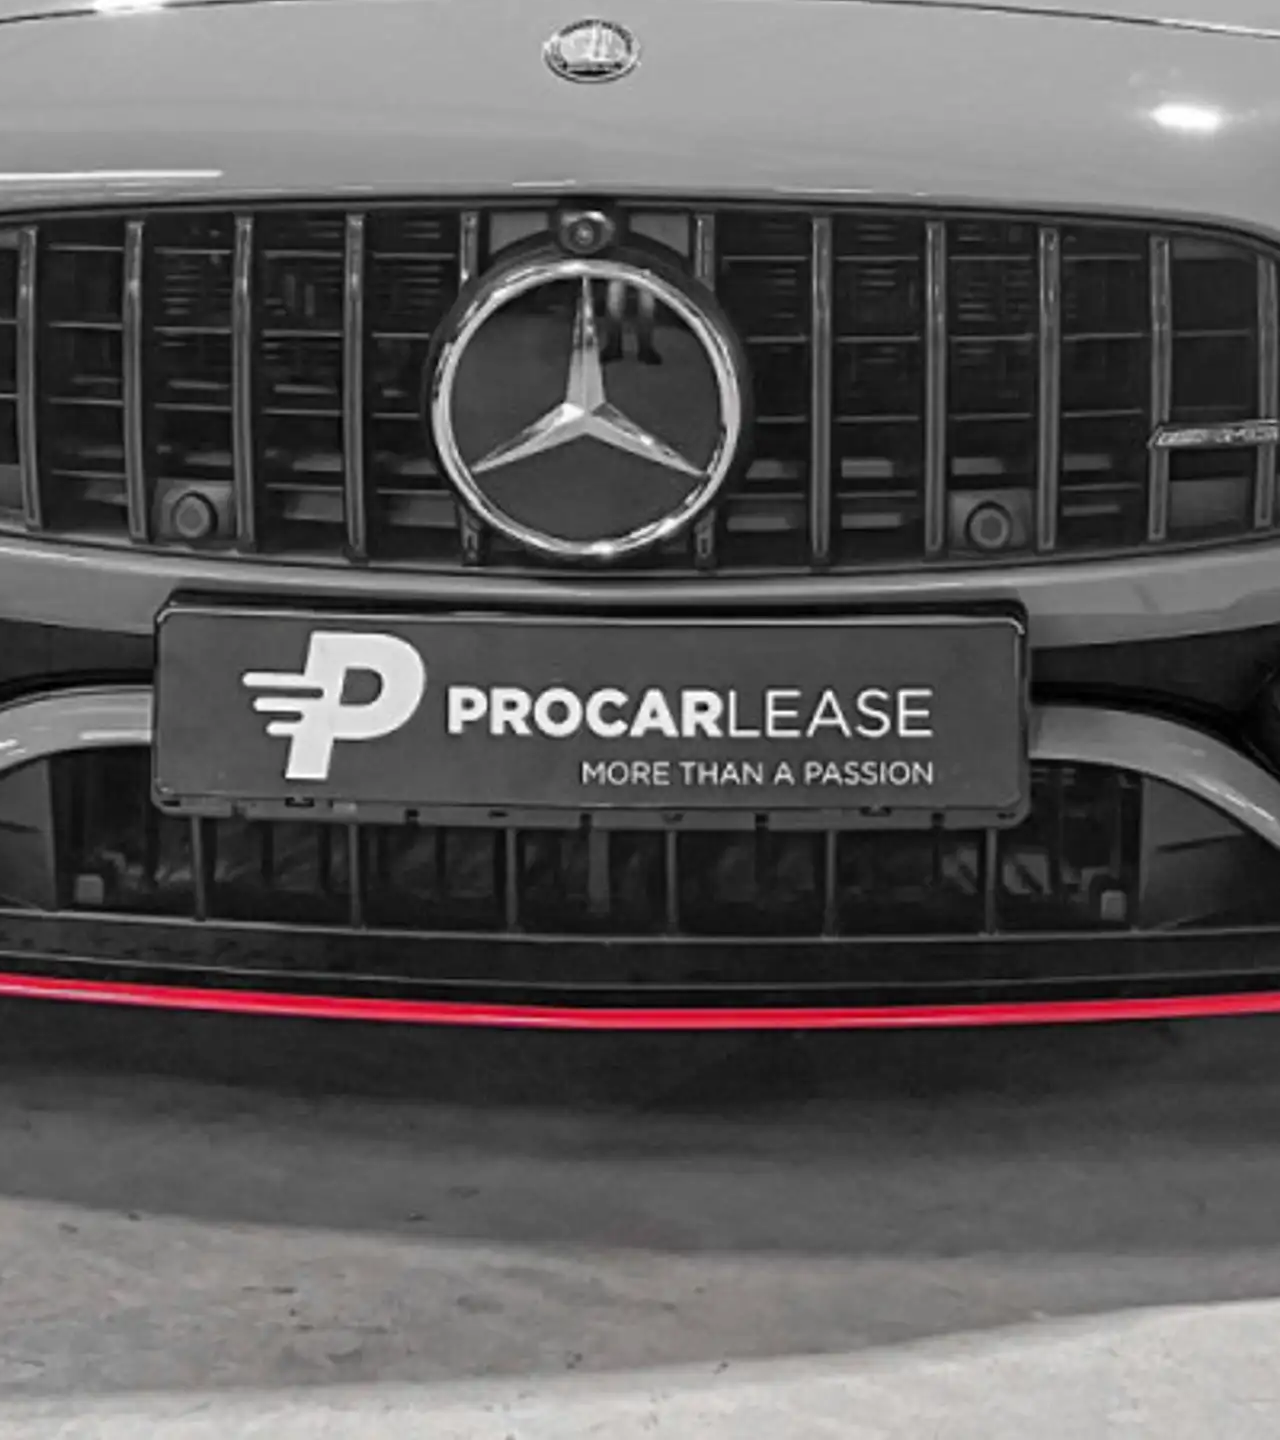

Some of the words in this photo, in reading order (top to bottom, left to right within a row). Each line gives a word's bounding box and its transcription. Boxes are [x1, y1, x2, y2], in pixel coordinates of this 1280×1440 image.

[448, 686, 933, 738] PROCARLEASE
[582, 760, 670, 786] MORE
[679, 760, 764, 786] THAN
[774, 760, 795, 786] A
[805, 760, 934, 786] PASSION
